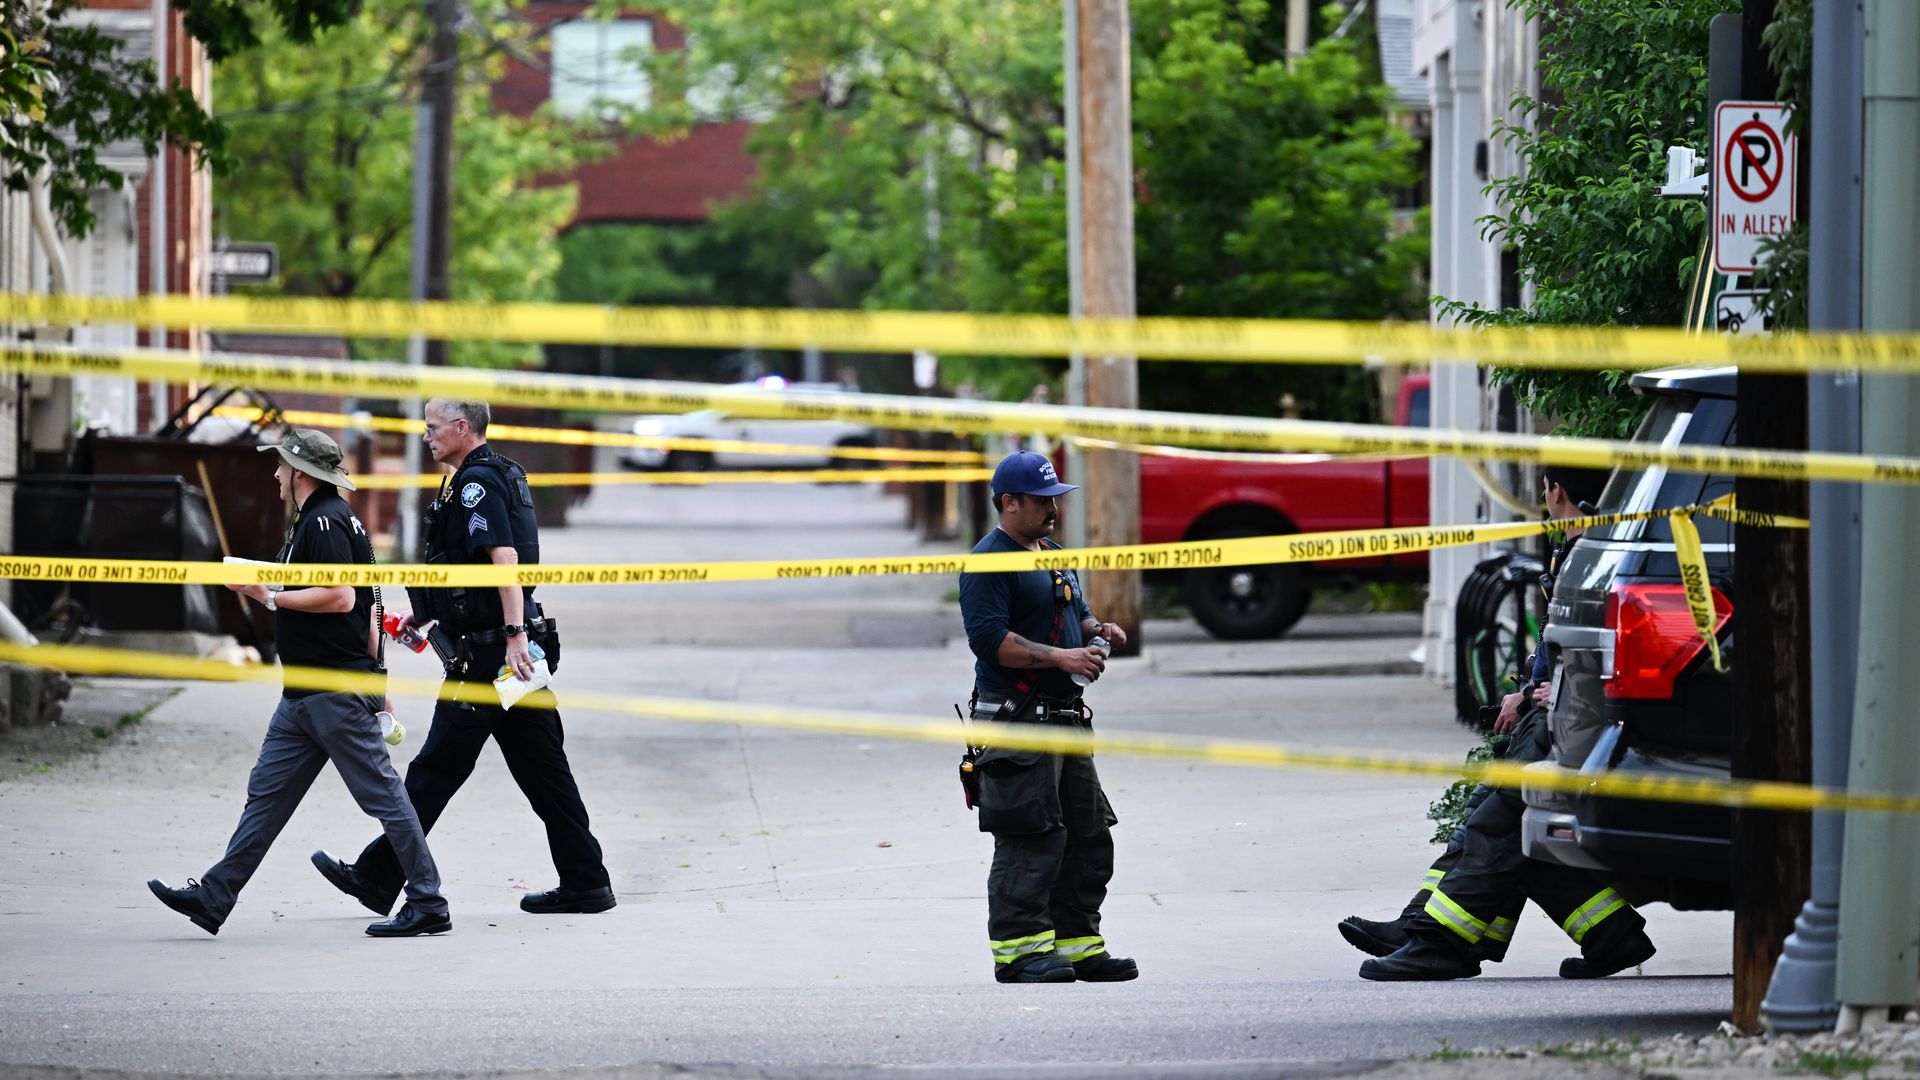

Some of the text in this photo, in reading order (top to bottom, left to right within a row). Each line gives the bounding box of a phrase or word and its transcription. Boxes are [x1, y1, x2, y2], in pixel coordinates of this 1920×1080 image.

[1721, 214, 1787, 235] IN ALLEY
[1289, 529, 1475, 559] POLICE LINE DO NOT CROSS
[1034, 547, 1222, 570] POLICE LINE DO NOT CROSS
[45, 563, 74, 578] NOT
[78, 564, 97, 578] DO
[102, 565, 133, 580] LINE
[138, 566, 188, 581] POLICE
[256, 568, 449, 584] POLICE LINE DO NOT CROSS
[516, 568, 708, 585] POLICE LINE DO NOT CROSS
[776, 566, 822, 579] CROSS
[828, 565, 855, 577] NOT
[858, 564, 877, 576] DO
[883, 563, 913, 575] LINE
[1682, 564, 1706, 603] CROSS
[400, 633, 412, 644] G
